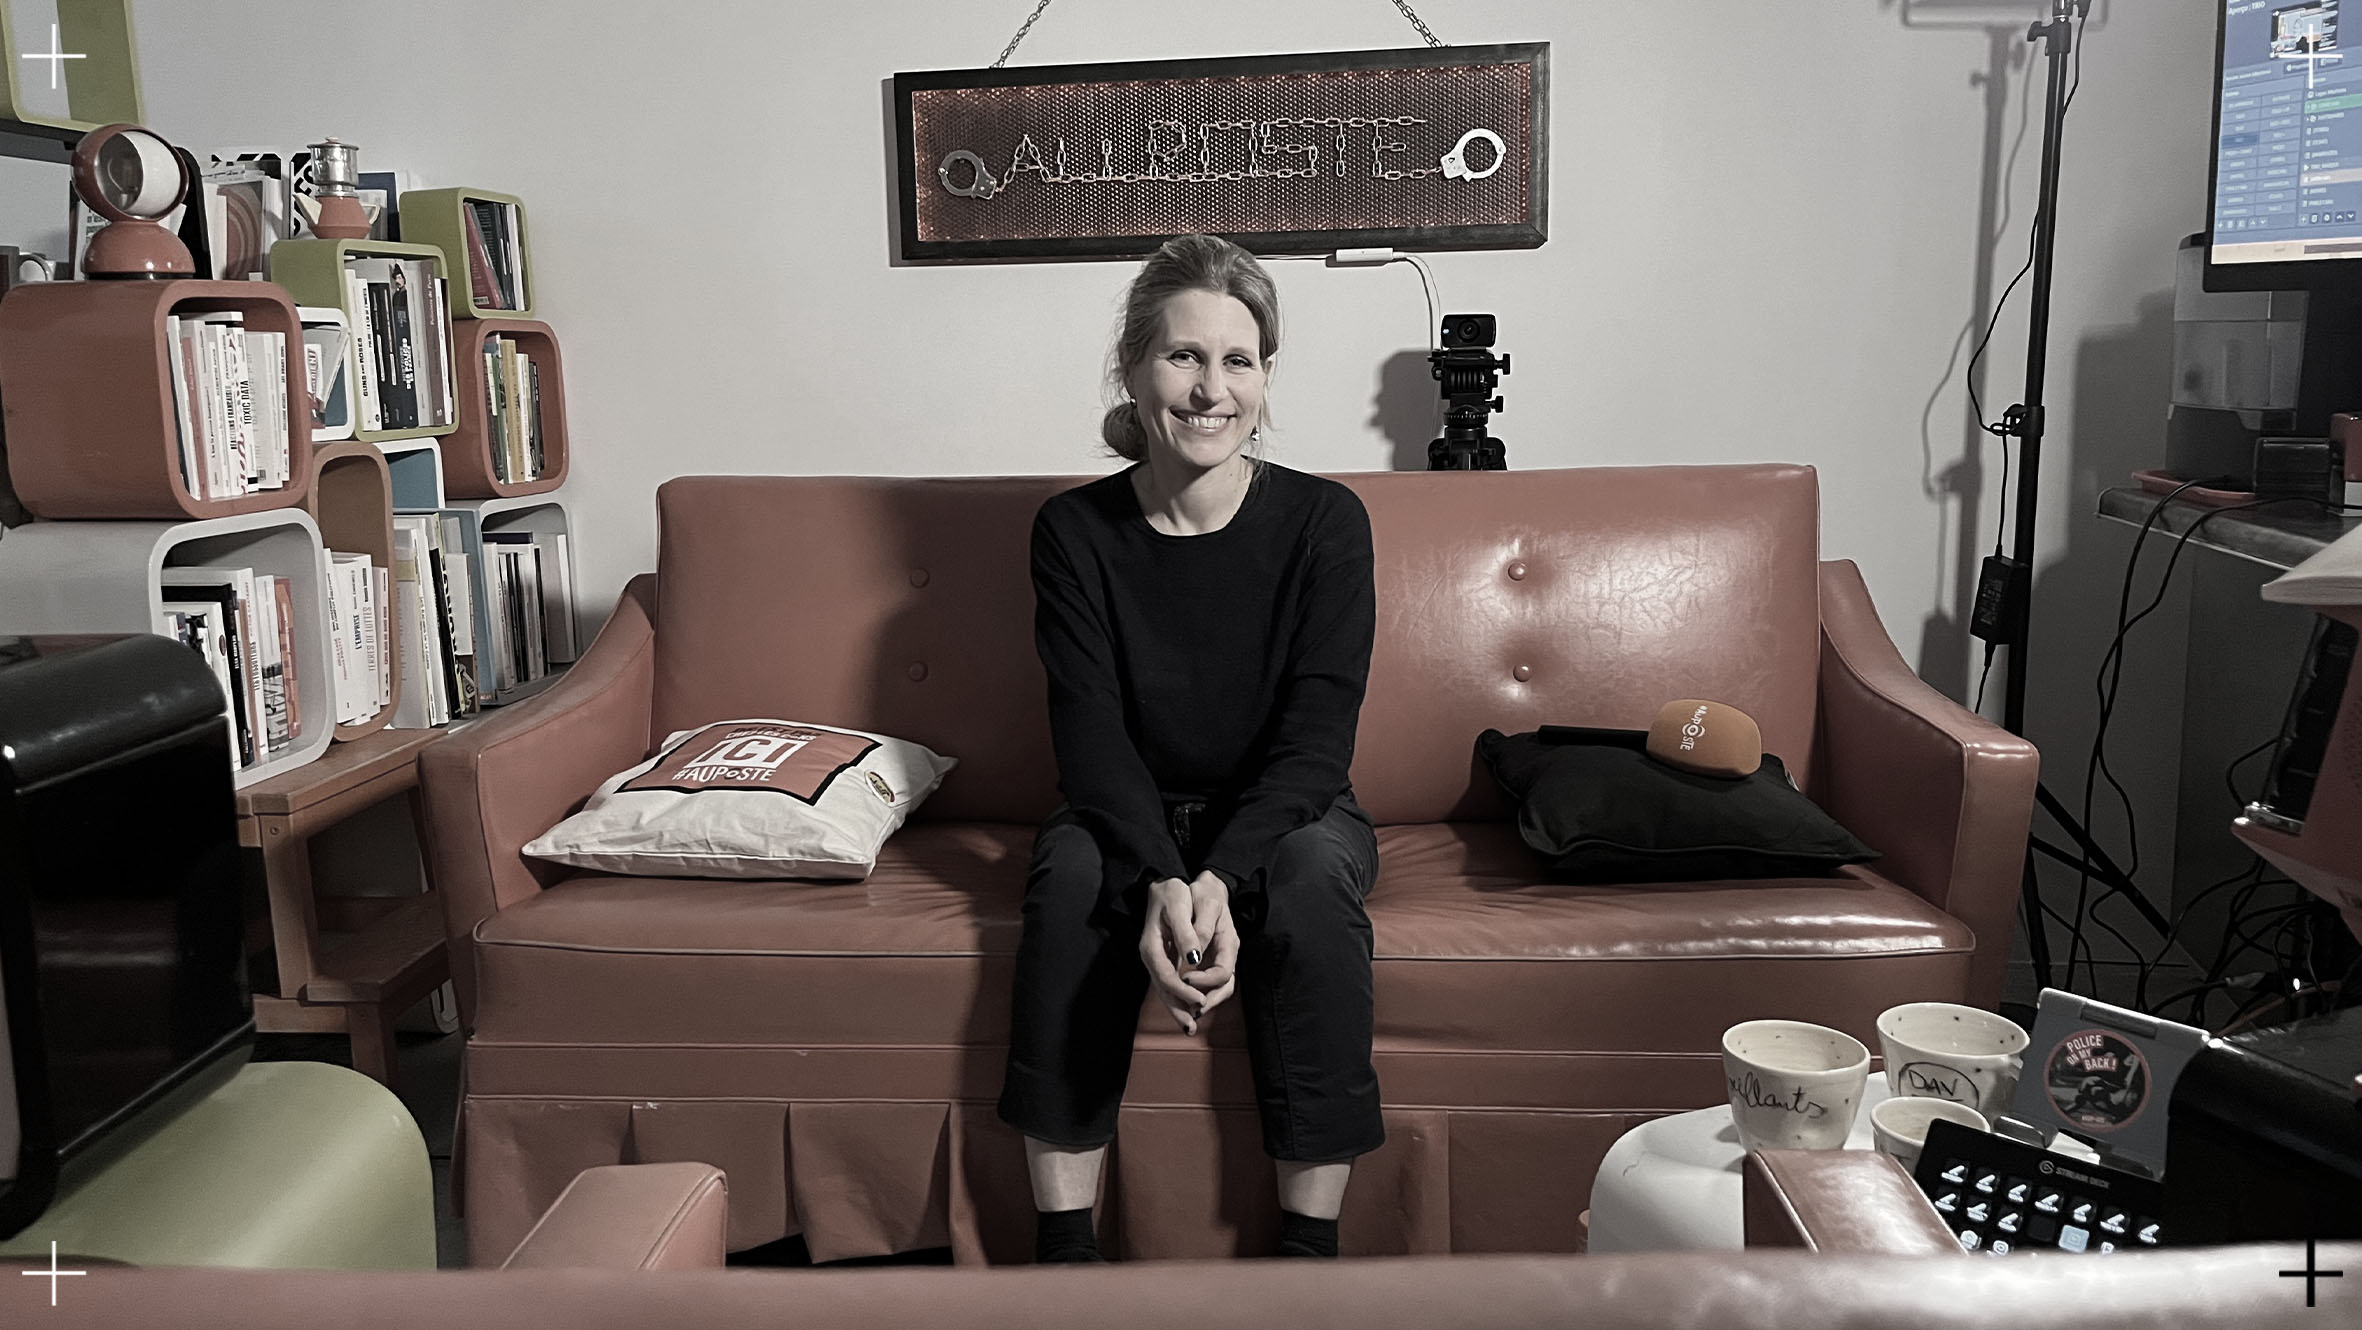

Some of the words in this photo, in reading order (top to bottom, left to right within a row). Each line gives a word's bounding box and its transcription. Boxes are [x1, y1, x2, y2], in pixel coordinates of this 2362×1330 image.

[357, 337, 365, 364] ROSES
[240, 380, 250, 400] DATA
[361, 375, 369, 397] GUNS
[243, 402, 252, 425] TOXIC
[362, 606, 374, 632] LUTTES
[353, 614, 362, 650] L'EMPRISE
[365, 634, 375, 644] DE
[366, 645, 376, 672] TERRES
[696, 738, 798, 763] ICI
[2066, 1034, 2103, 1053] POLICE
[2066, 1054, 2080, 1066] ON
[2078, 1048, 2092, 1059] MY
[2055, 1167, 2089, 1184] STREAM
[2089, 1176, 2111, 1189] DECK
